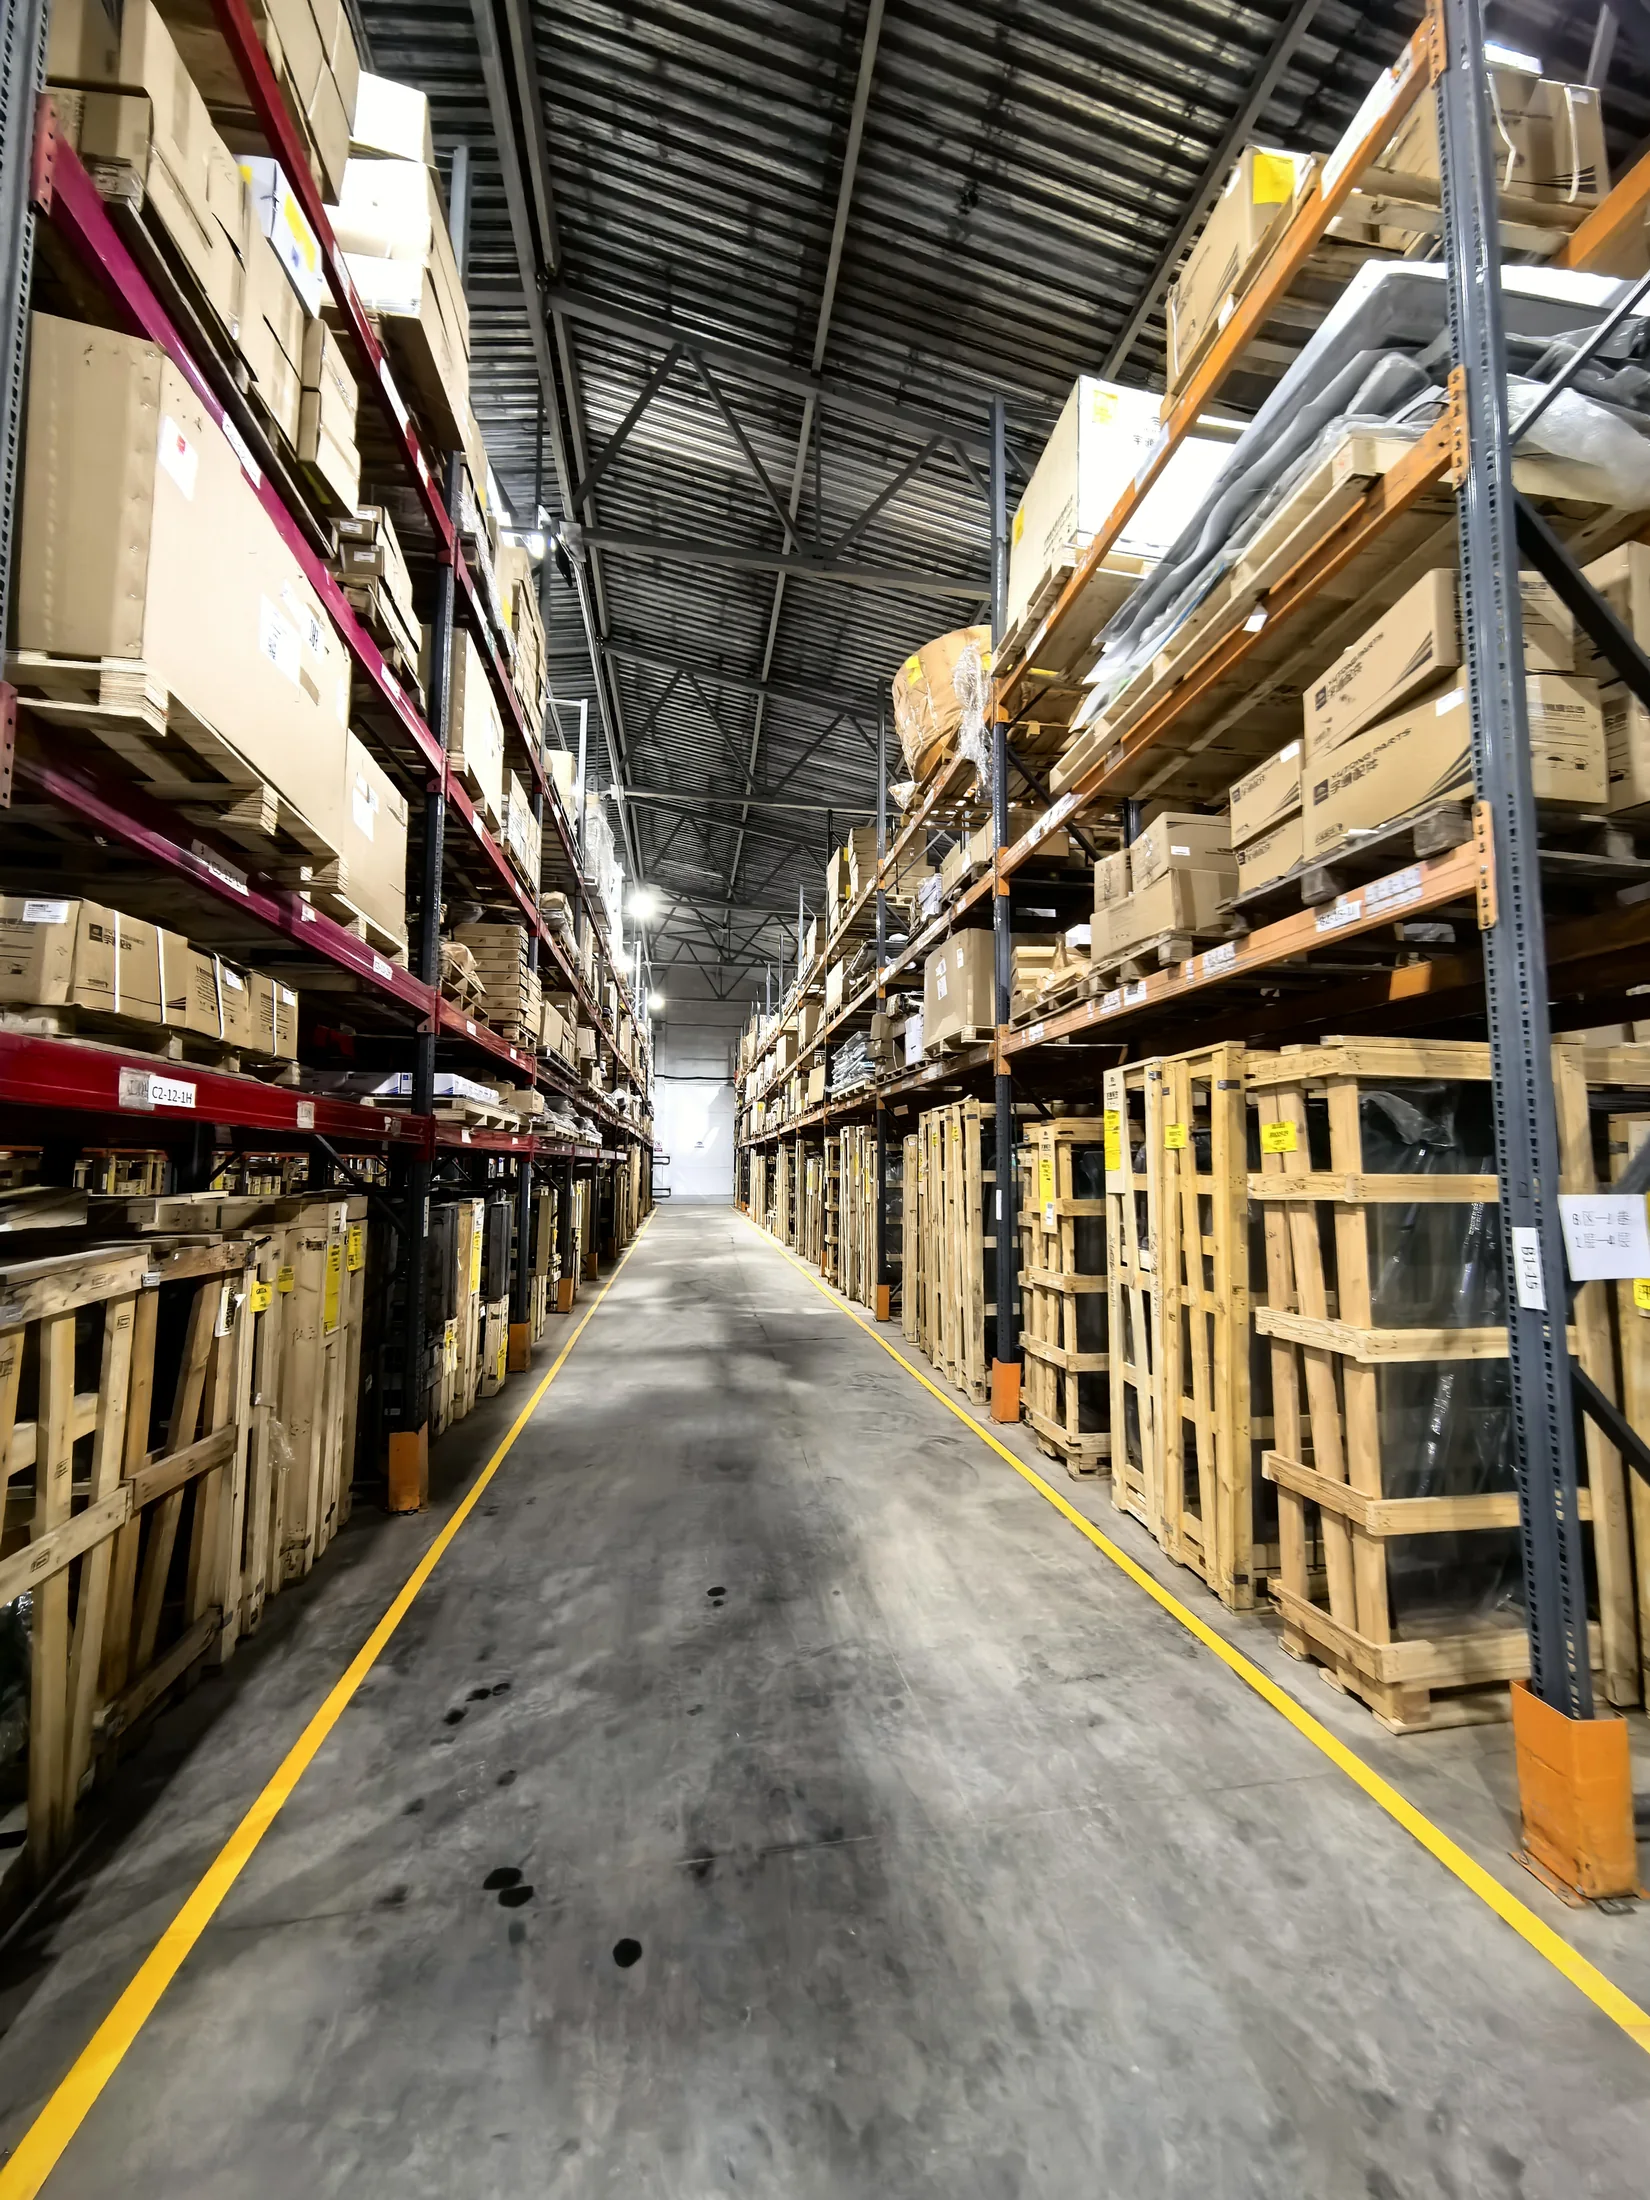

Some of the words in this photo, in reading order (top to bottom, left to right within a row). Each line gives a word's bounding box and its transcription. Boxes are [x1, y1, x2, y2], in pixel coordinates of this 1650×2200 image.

[1330, 752, 1371, 778] YUTONG
[152, 1086, 193, 1105] C2-12-1H
[1521, 1246, 1539, 1290] B1-15
